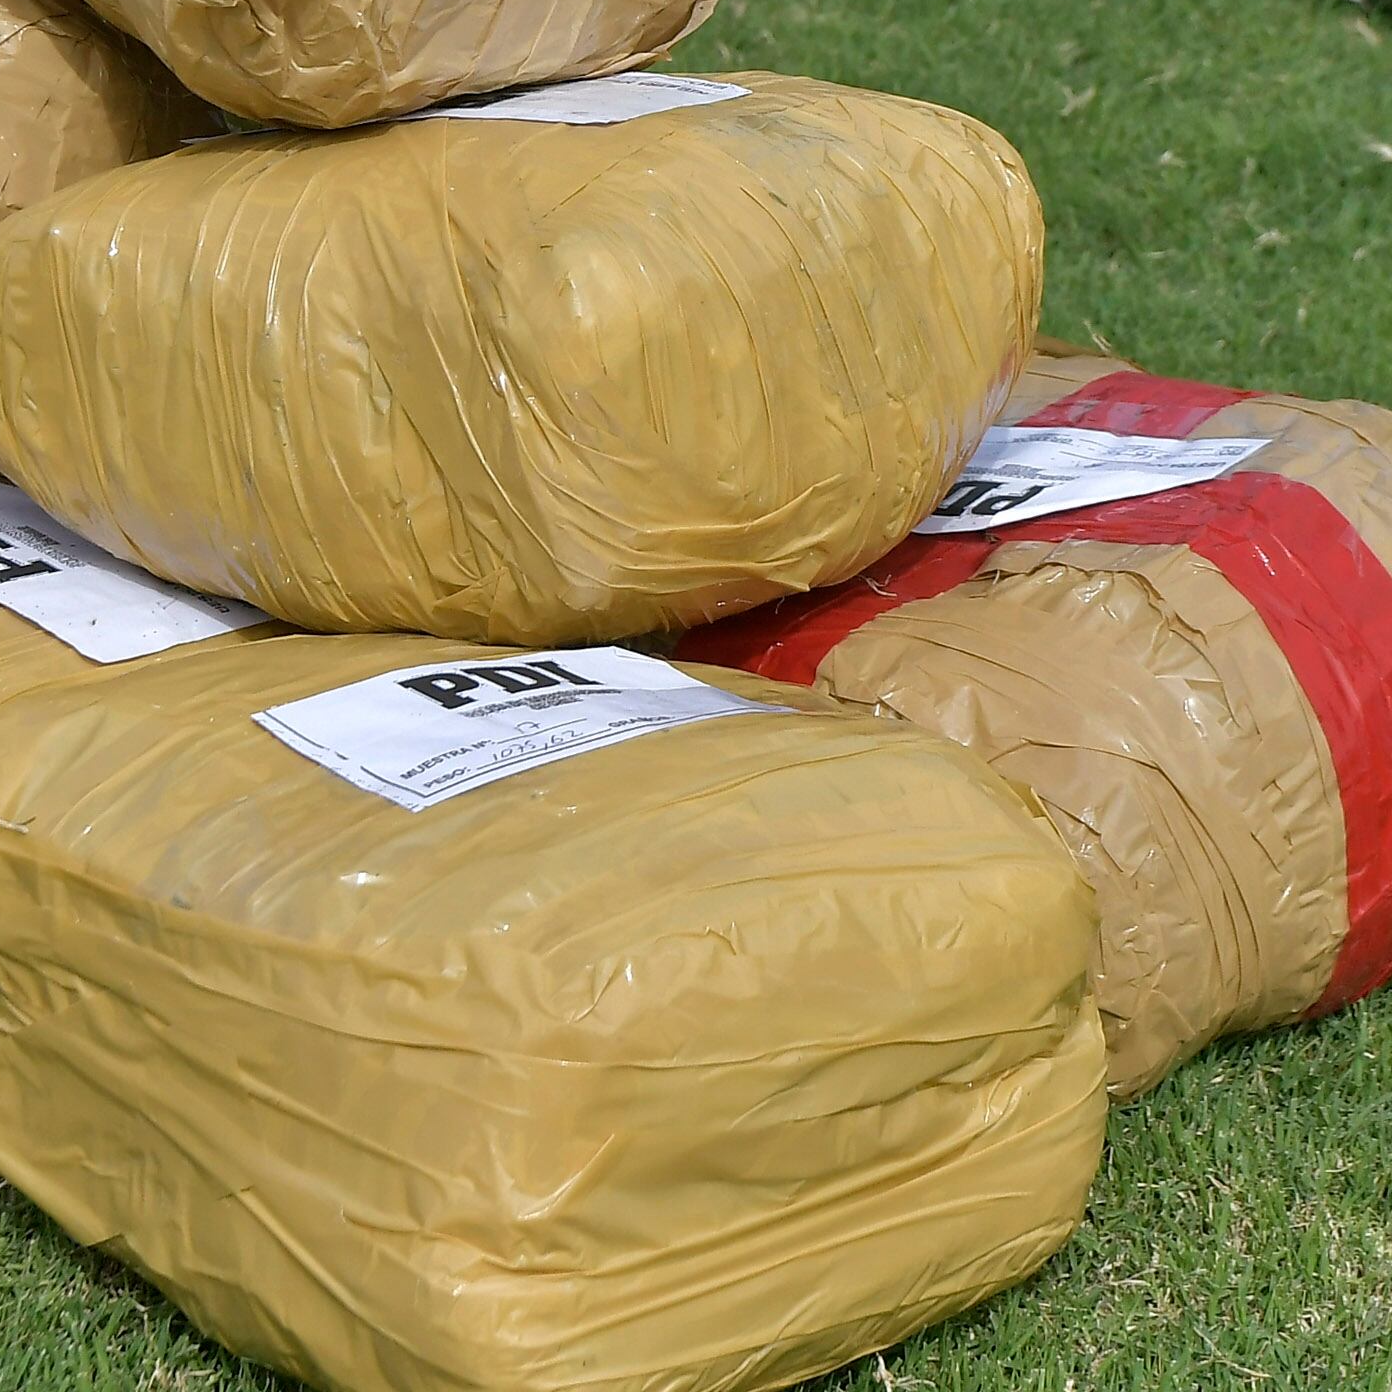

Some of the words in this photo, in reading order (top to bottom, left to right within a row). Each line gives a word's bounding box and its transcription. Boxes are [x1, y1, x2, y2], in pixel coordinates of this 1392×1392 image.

[931, 480, 1052, 517] PD
[397, 661, 606, 710] PDI
[400, 747, 473, 780] MUESTRA
